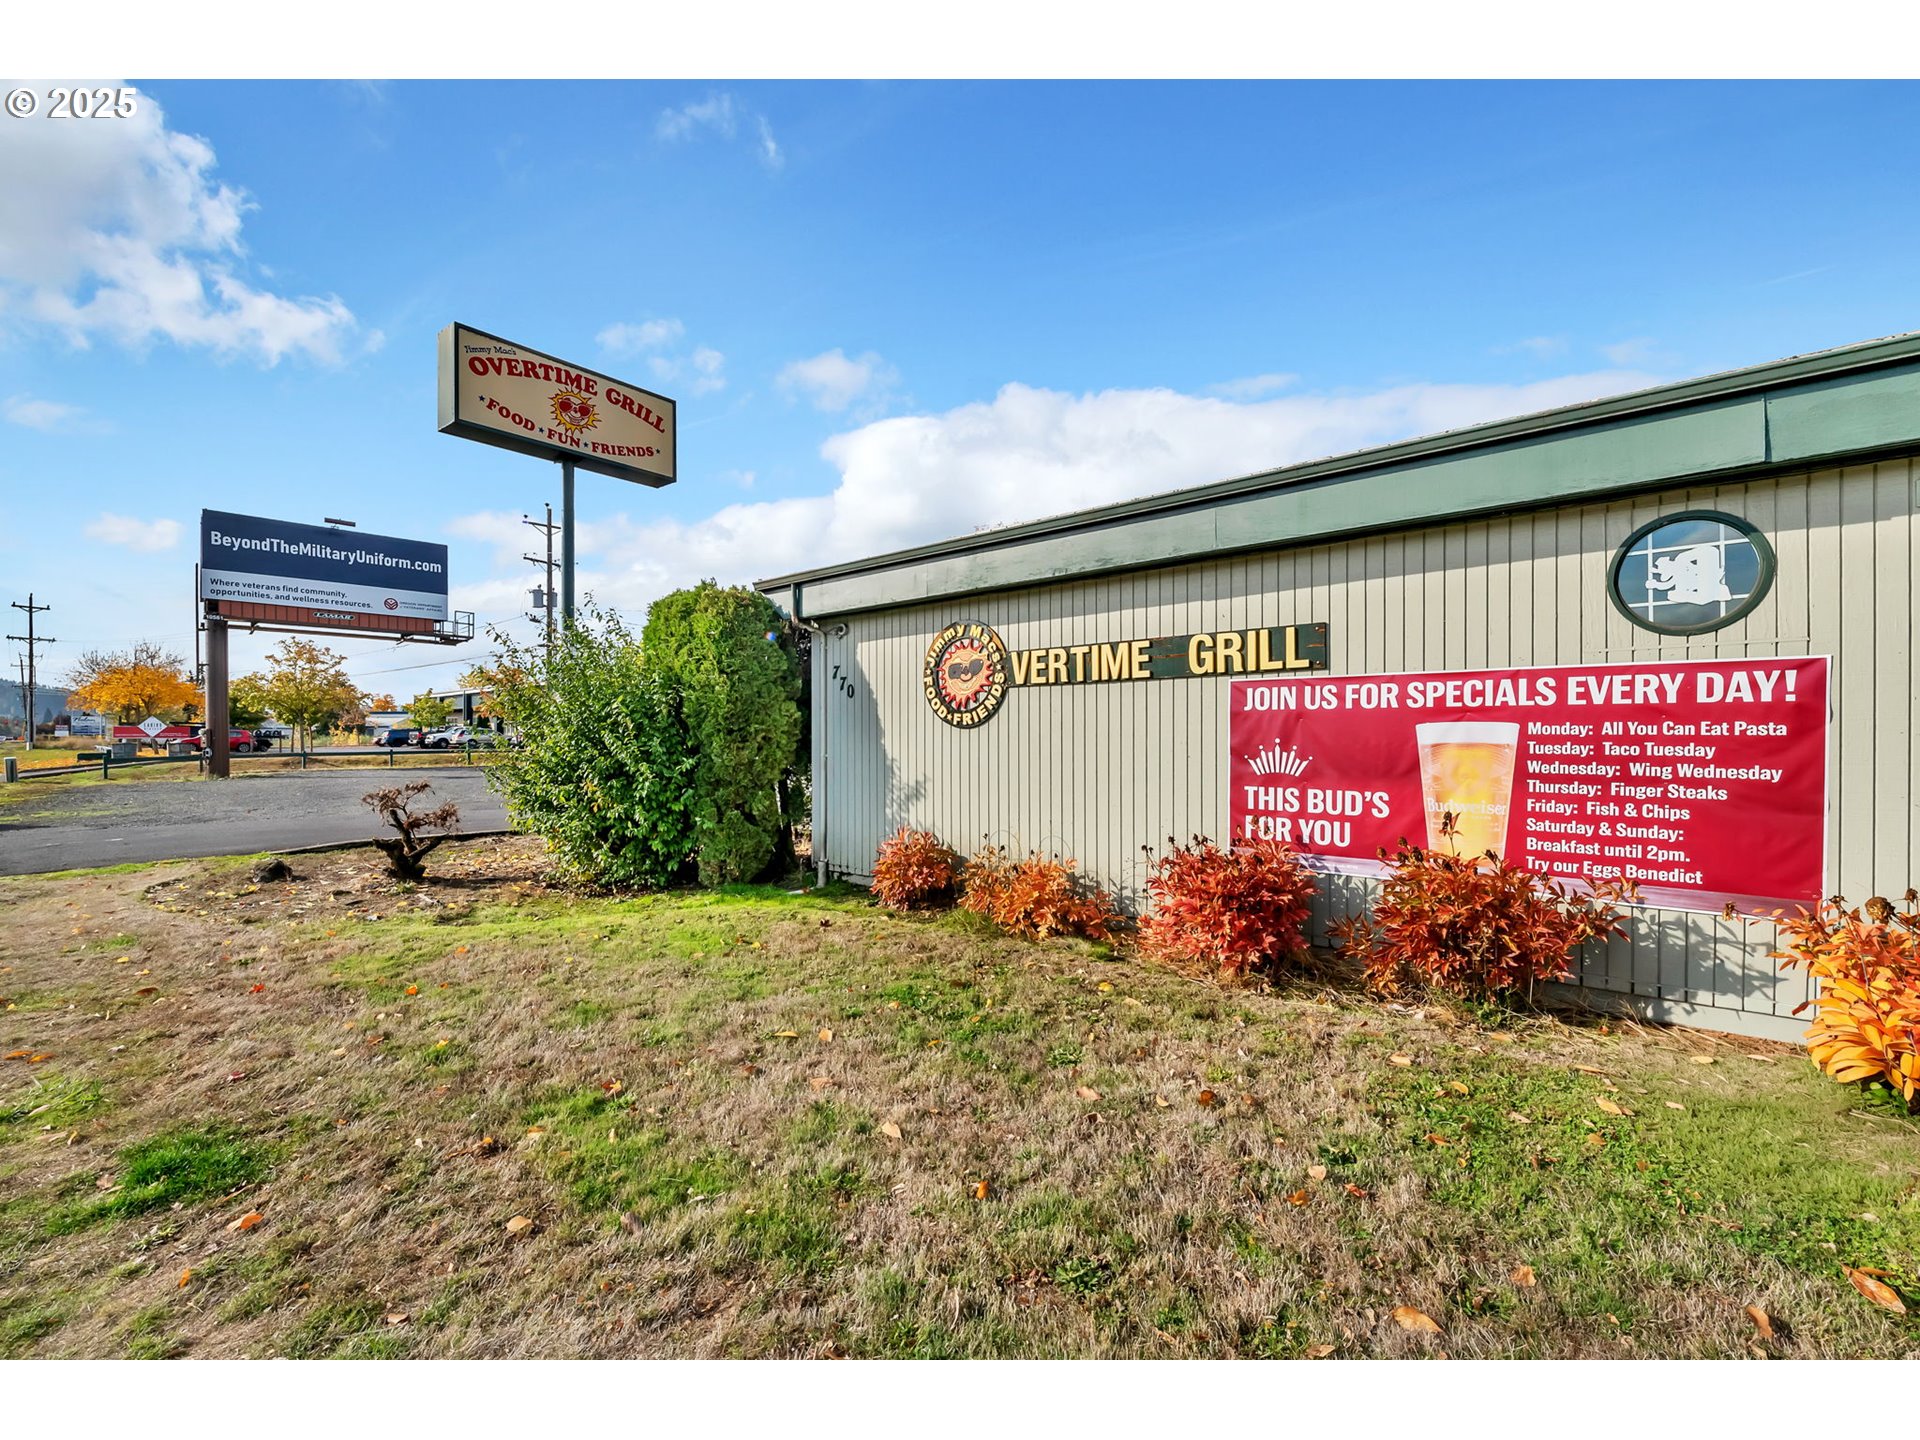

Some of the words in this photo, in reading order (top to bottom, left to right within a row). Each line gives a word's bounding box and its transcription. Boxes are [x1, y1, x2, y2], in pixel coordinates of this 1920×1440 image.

[464, 345, 491, 354] Jimmy
[493, 345, 517, 355] Mac's
[468, 356, 598, 397] OVERTIME
[605, 387, 665, 433] GRILL
[485, 397, 535, 431] FOOD
[547, 427, 581, 448] FUN
[591, 442, 654, 457] FRIENDS
[210, 531, 442, 573] BeyondTheMilitaryUniform.com
[210, 577, 240, 587] Where
[242, 582, 280, 591] veterans
[282, 585, 298, 593] find
[210, 588, 273, 600] opportunities,
[292, 596, 330, 605] wellness
[331, 599, 373, 608] resources.
[316, 612, 352, 620] LAMAR
[927, 624, 965, 667] Jimmy
[1188, 626, 1310, 675] GRILL
[832, 665, 855, 699] 770
[1243, 686, 1297, 711] JOIN
[1303, 684, 1338, 710] US
[1345, 682, 1399, 709] FOR
[1406, 676, 1557, 708] SPECIALS
[1567, 672, 1685, 706] EVERY
[1696, 669, 1797, 704] DAY!
[924, 677, 948, 718] FOOD
[953, 672, 1005, 725] FRIENDS
[1527, 721, 1593, 737] Monday:
[1602, 721, 1623, 735] All
[1626, 721, 1658, 736] You
[1662, 721, 1696, 736] Can
[1700, 721, 1729, 736] Eat
[1734, 721, 1787, 736] Pasta
[1527, 741, 1594, 757] Tuesday:
[1602, 742, 1640, 756] Taco
[1644, 742, 1716, 759] Tuesday
[1527, 760, 1621, 777] Wednesday:
[1629, 762, 1672, 779] Wing
[1677, 764, 1782, 782] Wednesday
[1244, 785, 1300, 813] THIS
[1307, 788, 1390, 818] BUD'S
[1527, 780, 1602, 796] Thursday:
[1610, 782, 1663, 799] Finger
[1667, 784, 1728, 800] Steaks
[1426, 797, 1507, 815] Budweiser
[1527, 799, 1578, 815] Friday:
[1586, 801, 1619, 816] Fish
[1624, 803, 1638, 817] &
[1642, 803, 1690, 821] Chips
[1245, 815, 1292, 842] FOR
[1298, 818, 1351, 848] YOU
[1526, 818, 1595, 836] Saturday
[1599, 822, 1612, 836] &
[1616, 823, 1684, 841] Sunday:
[1526, 837, 1600, 855] Breakfast
[1604, 842, 1642, 859] until
[1646, 846, 1691, 863] 2pm.
[1526, 856, 1550, 872] Try
[1553, 861, 1580, 873] our
[1583, 861, 1622, 878] Eggs
[1625, 864, 1703, 885] Benedict
